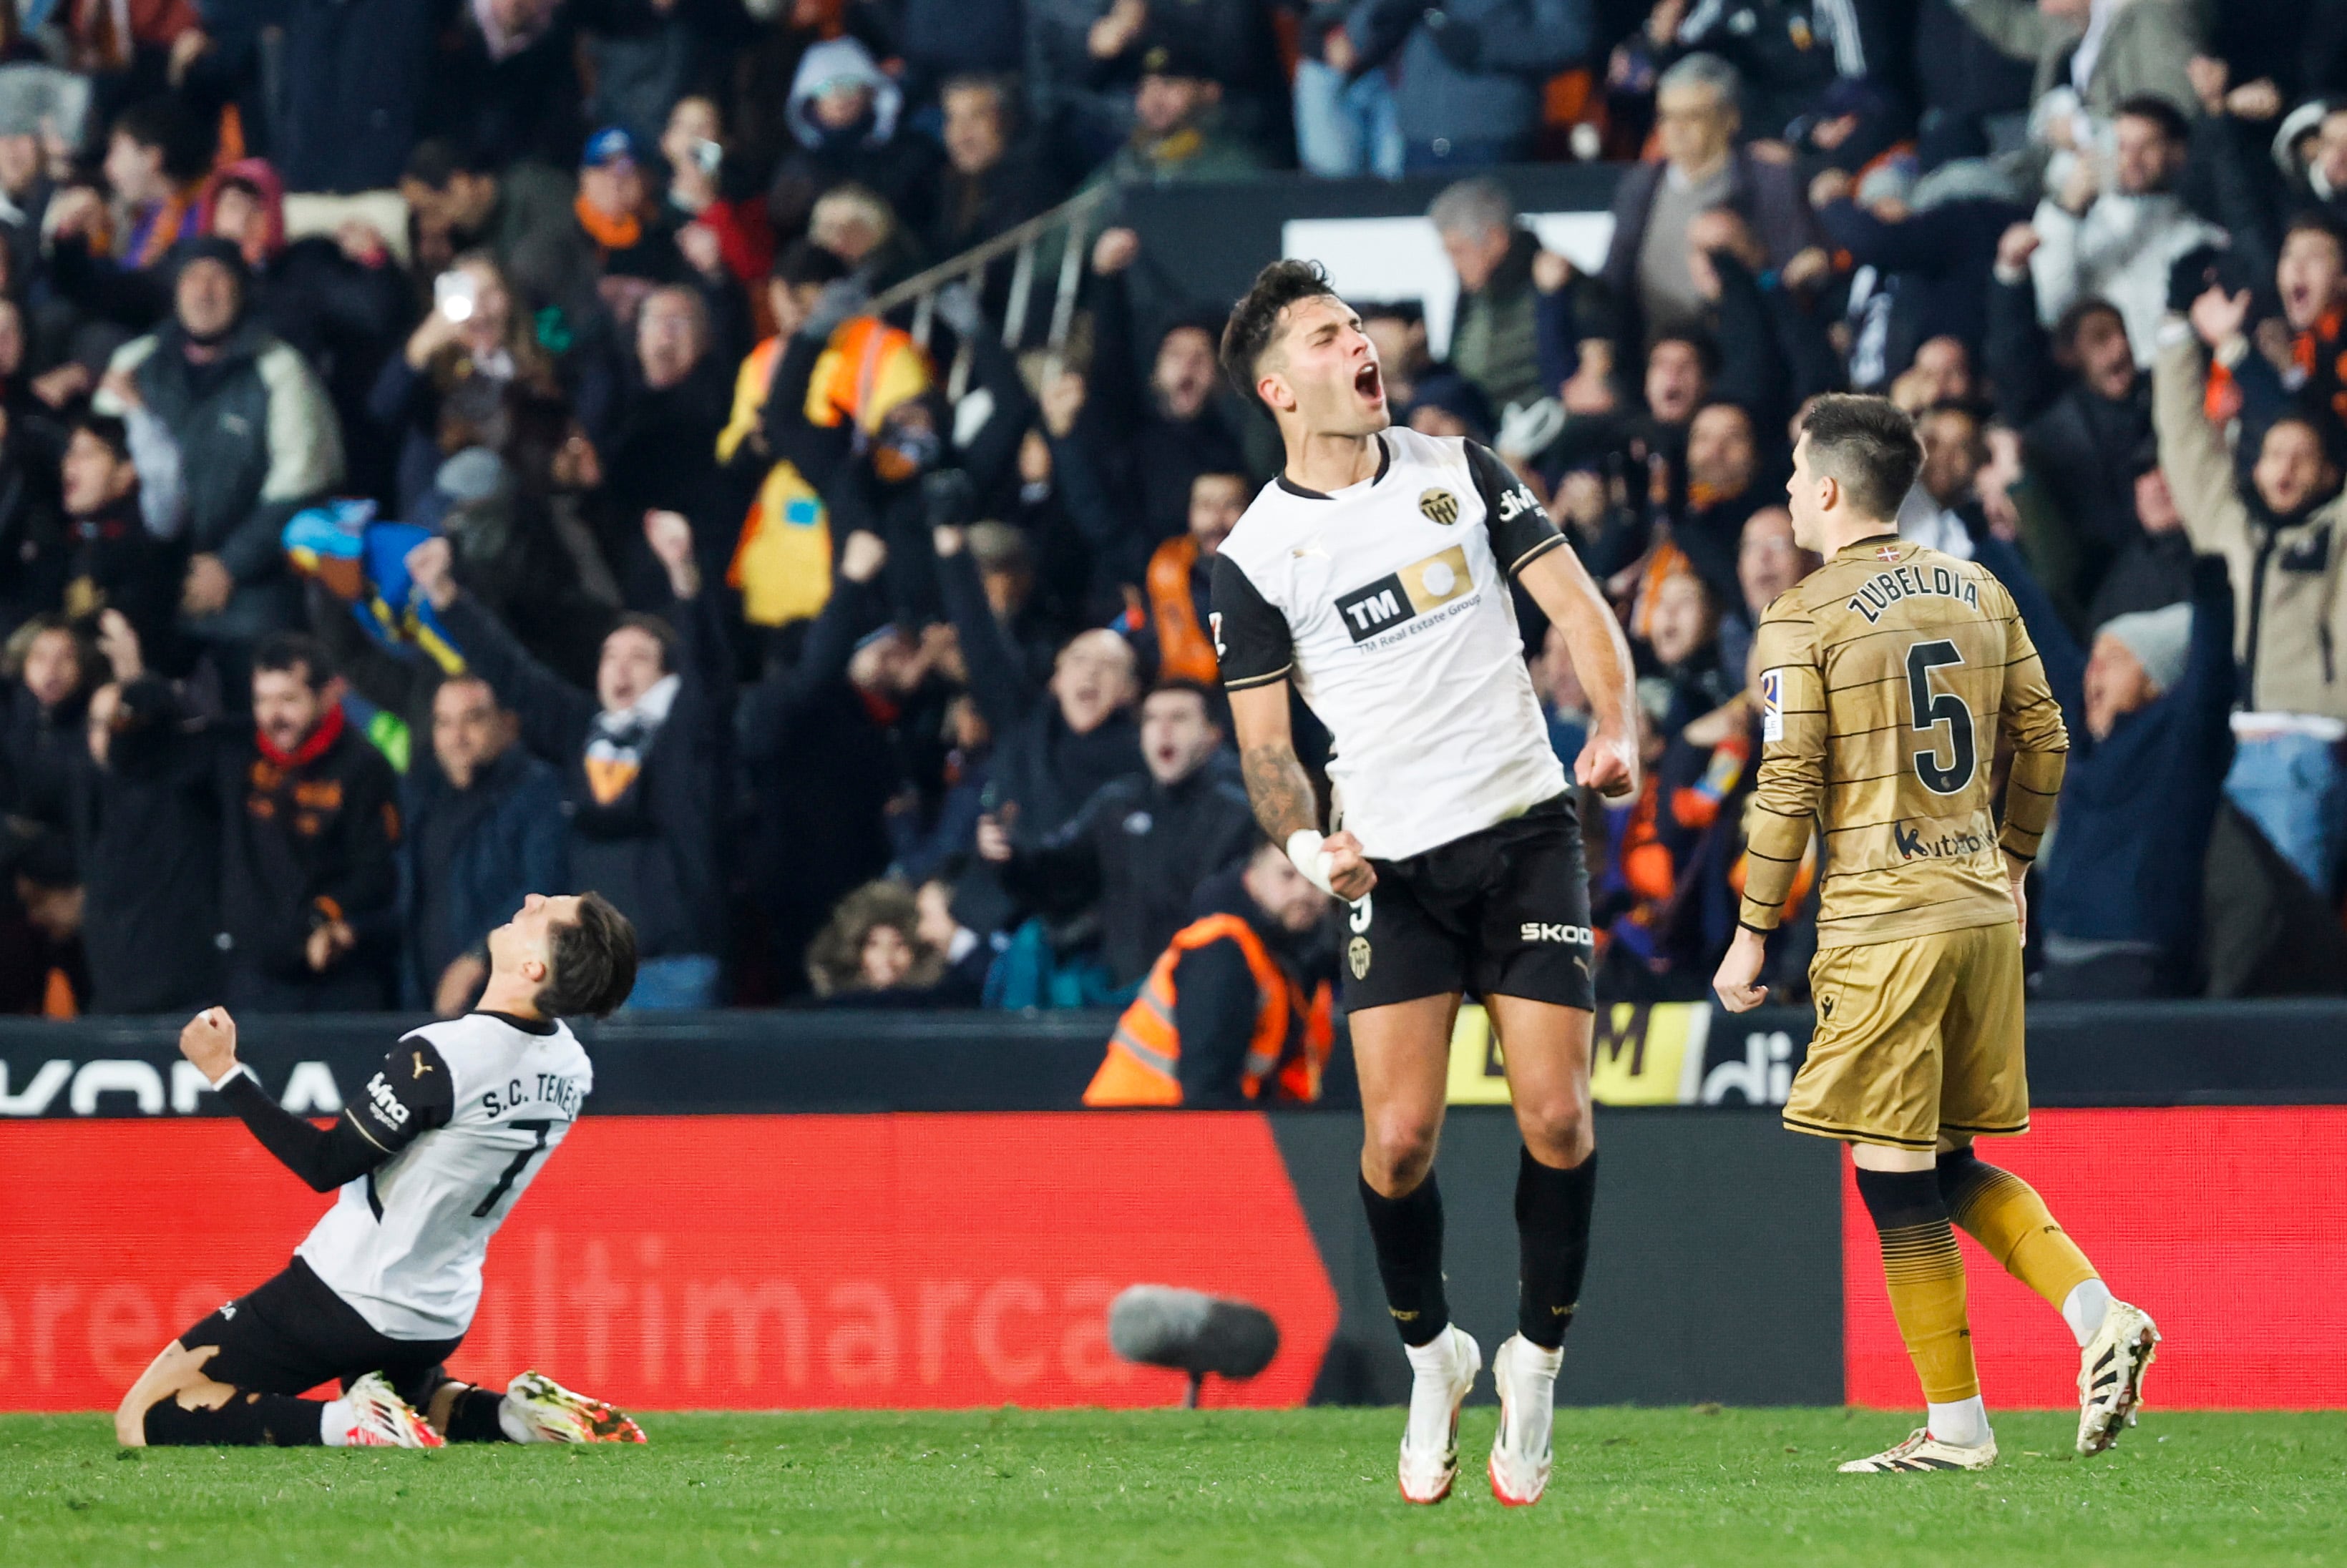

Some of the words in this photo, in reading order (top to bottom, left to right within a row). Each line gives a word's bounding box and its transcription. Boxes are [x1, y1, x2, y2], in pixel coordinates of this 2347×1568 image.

[1346, 588, 1401, 630] TM
[1380, 629, 1407, 648] Real
[1409, 613, 1446, 634] Estate
[1447, 594, 1482, 617] Group
[1847, 563, 1978, 627] ZUBELDIA
[1905, 638, 1977, 795] 5
[482, 1078, 529, 1118] S.C.
[470, 1119, 551, 1217] 7
